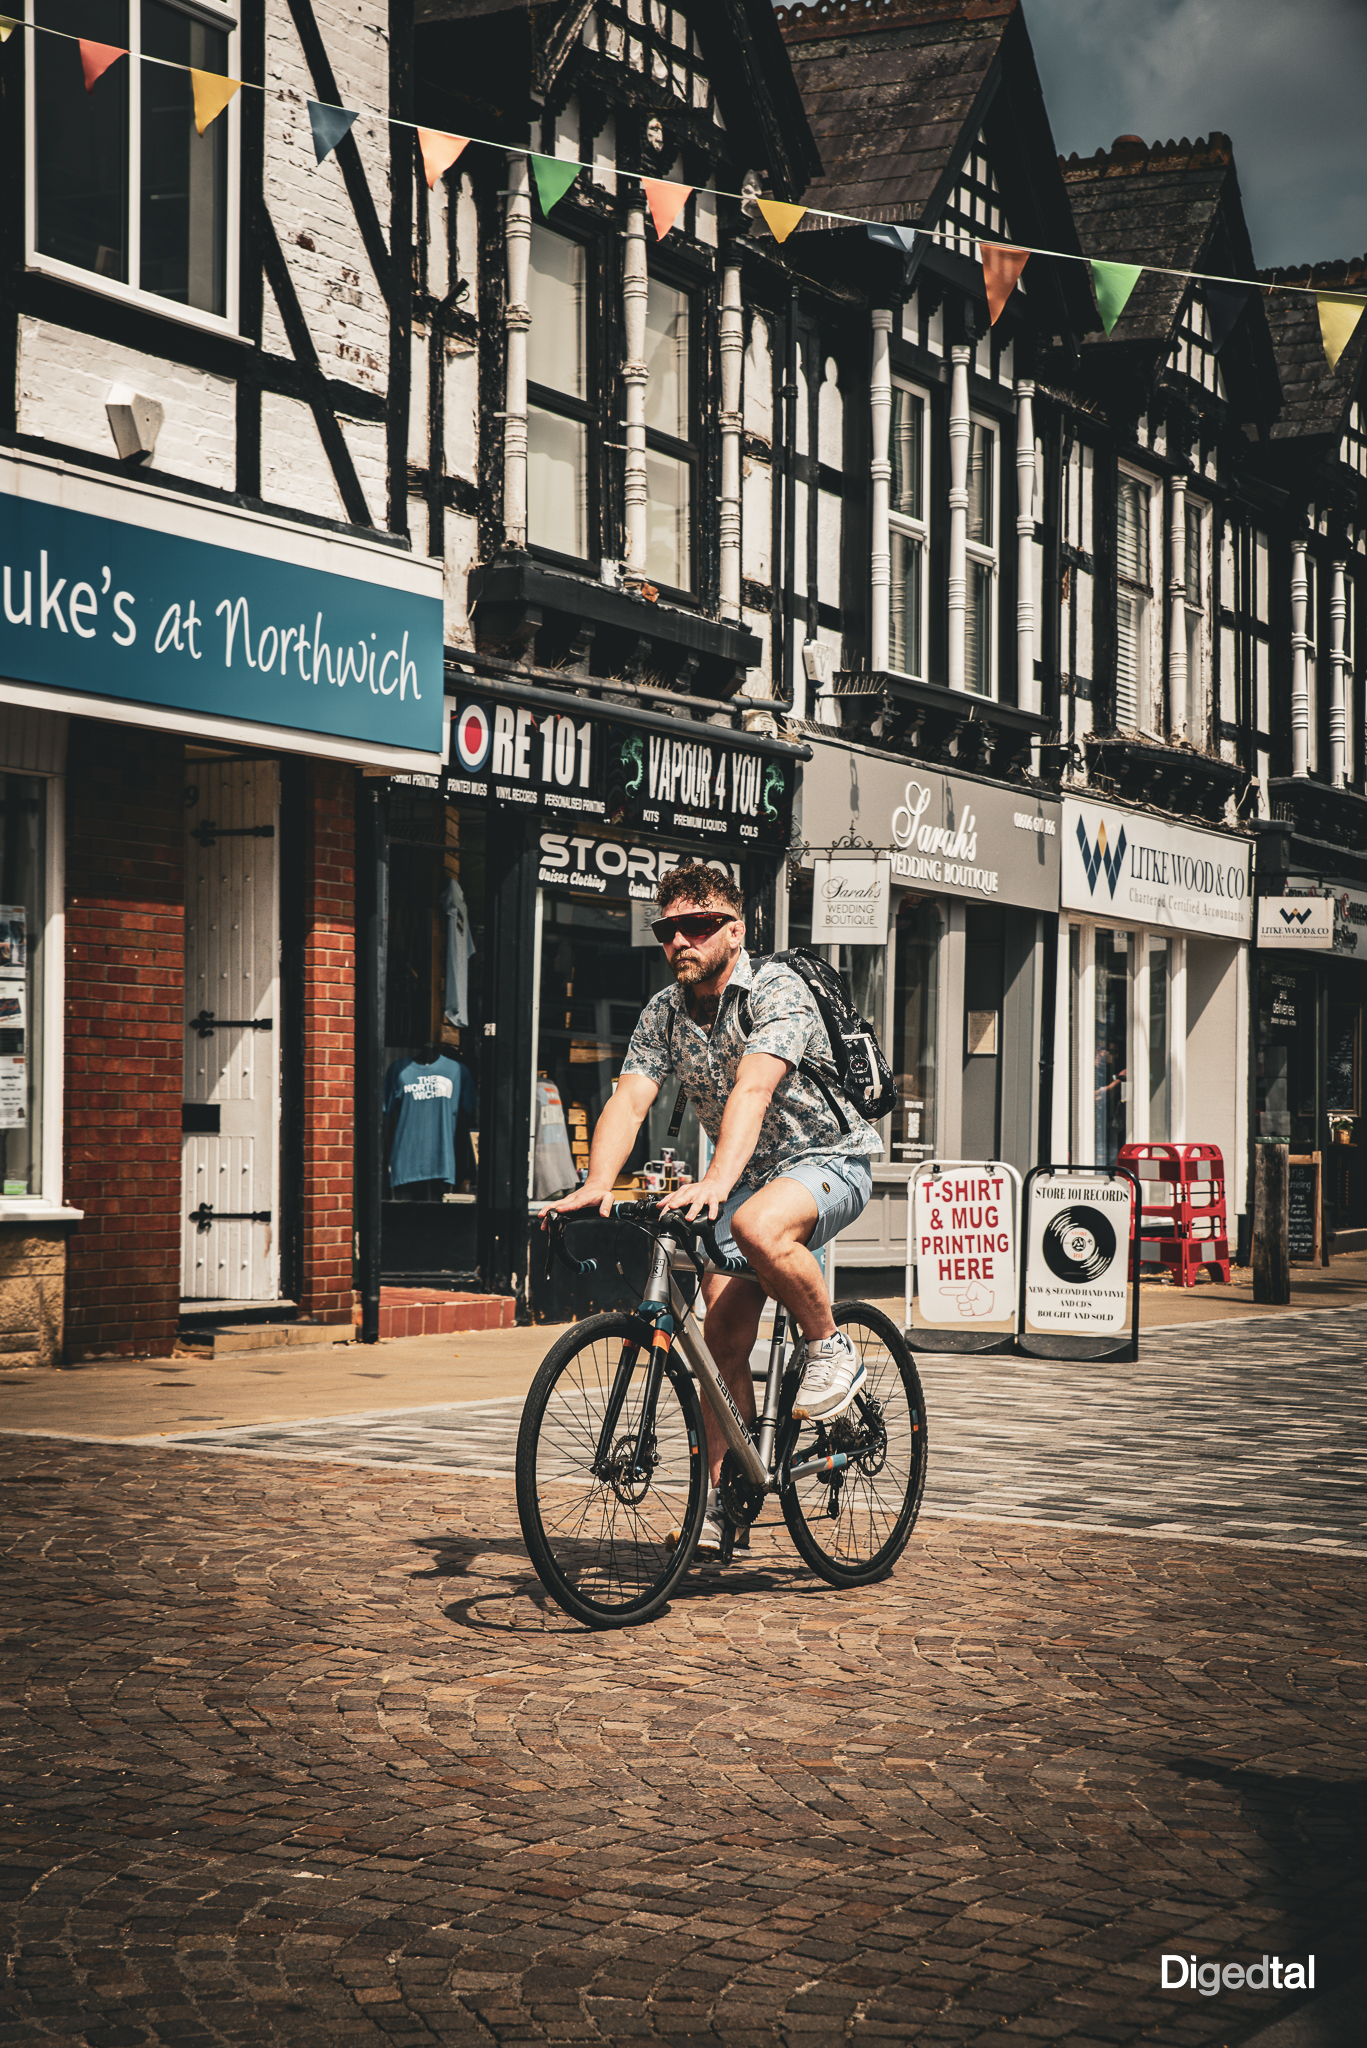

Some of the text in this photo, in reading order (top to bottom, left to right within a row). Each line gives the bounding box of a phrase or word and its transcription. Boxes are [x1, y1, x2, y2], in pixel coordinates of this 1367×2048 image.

[3, 549, 422, 701] uke's at Northwich
[539, 714, 592, 789] 101
[412, 774, 439, 789] PRINTING
[649, 735, 762, 817] VAPOUR 4 YOU
[447, 778, 488, 797] PRINTED MUGS
[495, 786, 538, 804] VINYL RECORDS
[544, 793, 606, 814] PERSONALISED PRINTING
[643, 809, 660, 823] KITS
[673, 813, 727, 833] PREMIUM LIQUIDS
[891, 781, 978, 862] Sarah's
[739, 824, 759, 838] COILS
[538, 867, 607, 893] Unisex Clothing
[884, 850, 999, 896] WEDDING BOUTIQUE
[1130, 844, 1245, 900] LITKE WOOD & CO
[821, 875, 881, 899] Sarah's
[827, 903, 874, 914] WEDDING
[1128, 887, 1244, 923] Chartered Certified Accountants
[825, 914, 875, 926] BOUTIQUE
[1261, 926, 1329, 935] LITKE WOOD & CO
[403, 1082, 437, 1093] NORTH
[417, 1075, 437, 1084] THE
[412, 1090, 437, 1101] WICH
[922, 1178, 1004, 1203] T-SHIRT
[1035, 1187, 1066, 1200] STORE
[1083, 1187, 1129, 1202] RECORDS
[930, 1206, 998, 1230] & MUG
[921, 1233, 1009, 1255] PRINTING
[938, 1257, 994, 1281] HERE
[1028, 1286, 1045, 1295] NEW
[1052, 1287, 1080, 1297] SECOND
[1081, 1288, 1103, 1298] HAND
[1103, 1289, 1126, 1299] VINYL
[1060, 1300, 1075, 1308] AND
[1037, 1310, 1114, 1322] BOUGHT AND SOLD
